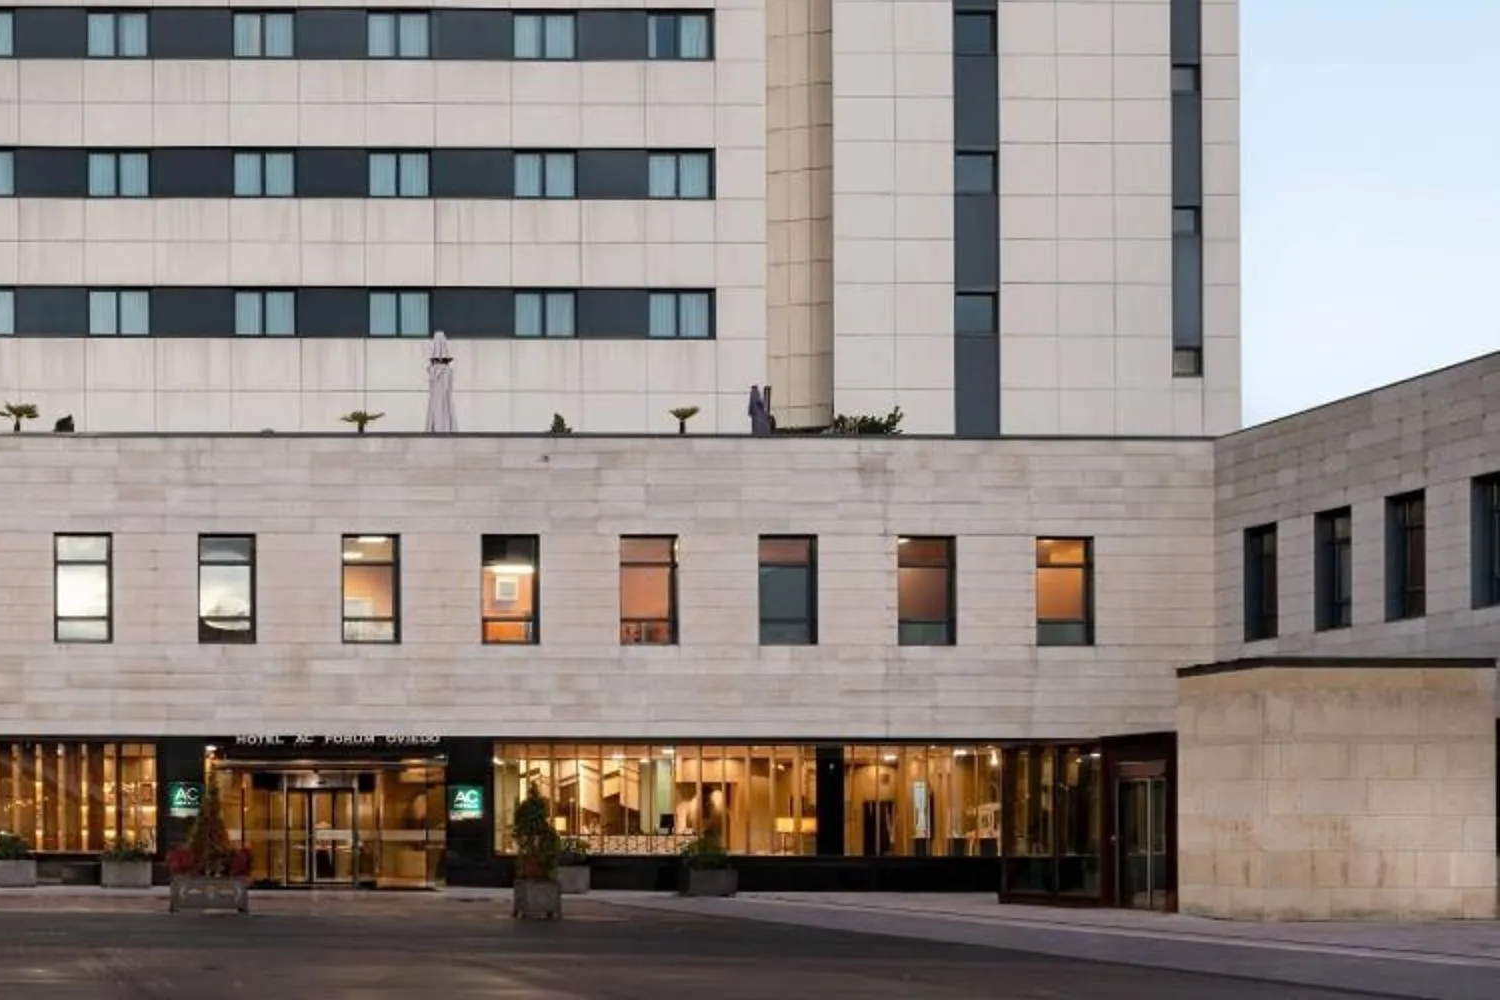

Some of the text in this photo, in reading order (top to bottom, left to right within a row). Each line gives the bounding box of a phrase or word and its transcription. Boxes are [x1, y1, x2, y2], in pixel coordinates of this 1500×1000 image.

[235, 734, 284, 745] HOTEL
[324, 734, 375, 744] FORUM
[174, 787, 199, 801] AC
[454, 789, 479, 803] AC
